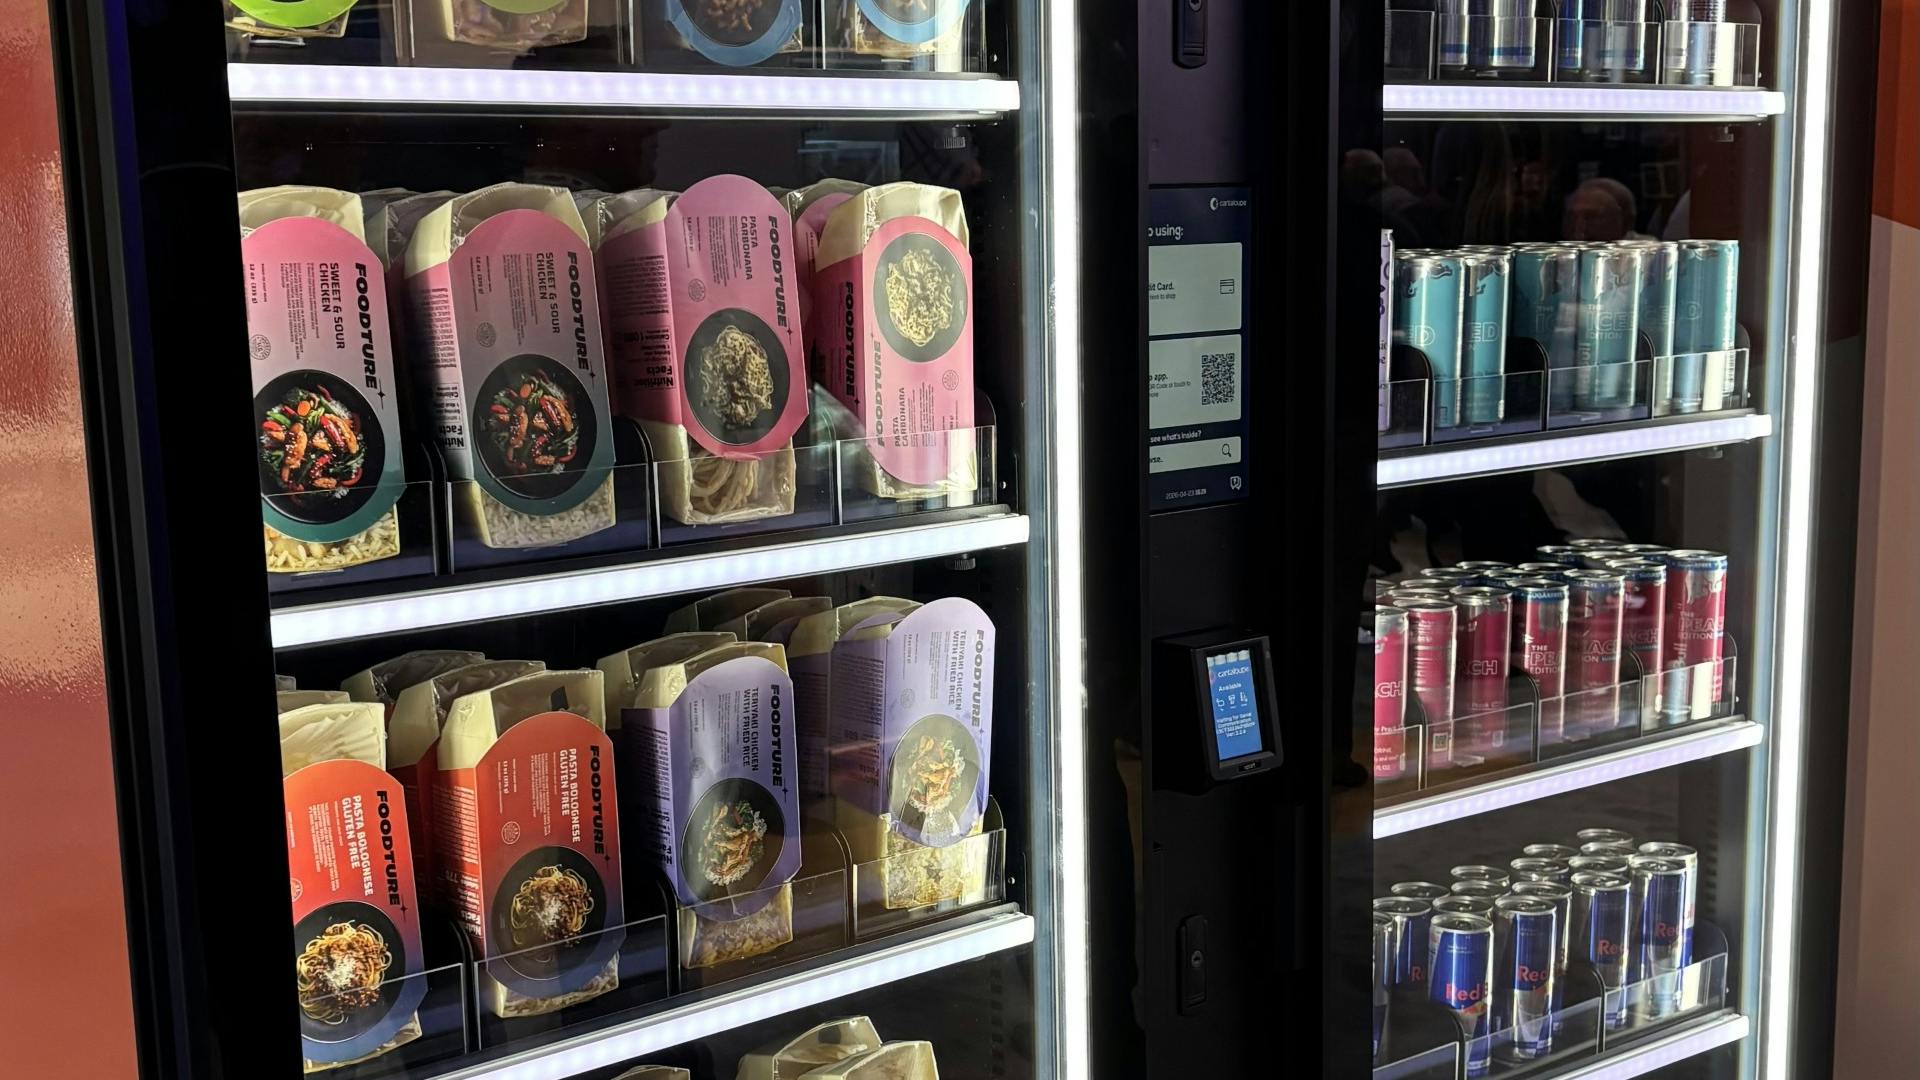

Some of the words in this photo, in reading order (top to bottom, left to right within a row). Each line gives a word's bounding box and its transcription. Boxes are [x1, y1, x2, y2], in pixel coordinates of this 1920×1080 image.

[741, 216, 753, 280] CARBONARA
[749, 216, 758, 248] PASTA
[1155, 224, 1184, 240] using:
[319, 262, 332, 313] CHICKEN
[329, 262, 342, 303] SWEET
[536, 252, 548, 300] CHICKEN
[545, 252, 557, 289] SWEET
[768, 215, 788, 328] FOODTURE
[333, 305, 342, 314] &
[548, 292, 557, 301] &
[567, 251, 590, 370] FOODTURE
[334, 316, 346, 350] SOUR
[354, 262, 378, 390] FOODTURE
[550, 303, 561, 334] SOUR
[845, 281, 855, 397] FOODTURE
[873, 340, 885, 447] FOODTURE
[892, 416, 901, 447] PASTA
[898, 387, 909, 447] CARBONARA
[951, 630, 960, 654] WITH
[957, 630, 967, 670] TERIYAKI
[949, 656, 958, 683] FRIED
[971, 629, 985, 727] FOODTURE
[1530, 666, 1561, 675] EDITIO
[743, 689, 751, 713] WITH
[751, 687, 759, 729] TERIYAKI
[948, 685, 956, 705] RICE
[955, 672, 964, 711] CHICKEN
[743, 716, 751, 744] FRIED
[770, 684, 783, 787] FOODTURE
[559, 749, 568, 789] GLUTEN
[568, 748, 577, 780] PASTA
[743, 745, 751, 767] RICE
[751, 731, 759, 772] CHICKEN
[341, 797, 356, 840] GLUTEN
[352, 795, 365, 830] PASTA
[561, 791, 570, 817] FREE
[570, 782, 581, 843] BOLOGNESE
[590, 744, 605, 854] FOODTURE
[347, 841, 360, 869] FREE
[357, 831, 374, 896] BOLOGNESE
[376, 790, 401, 906] FOODTURE
[1446, 983, 1480, 1001] Red
